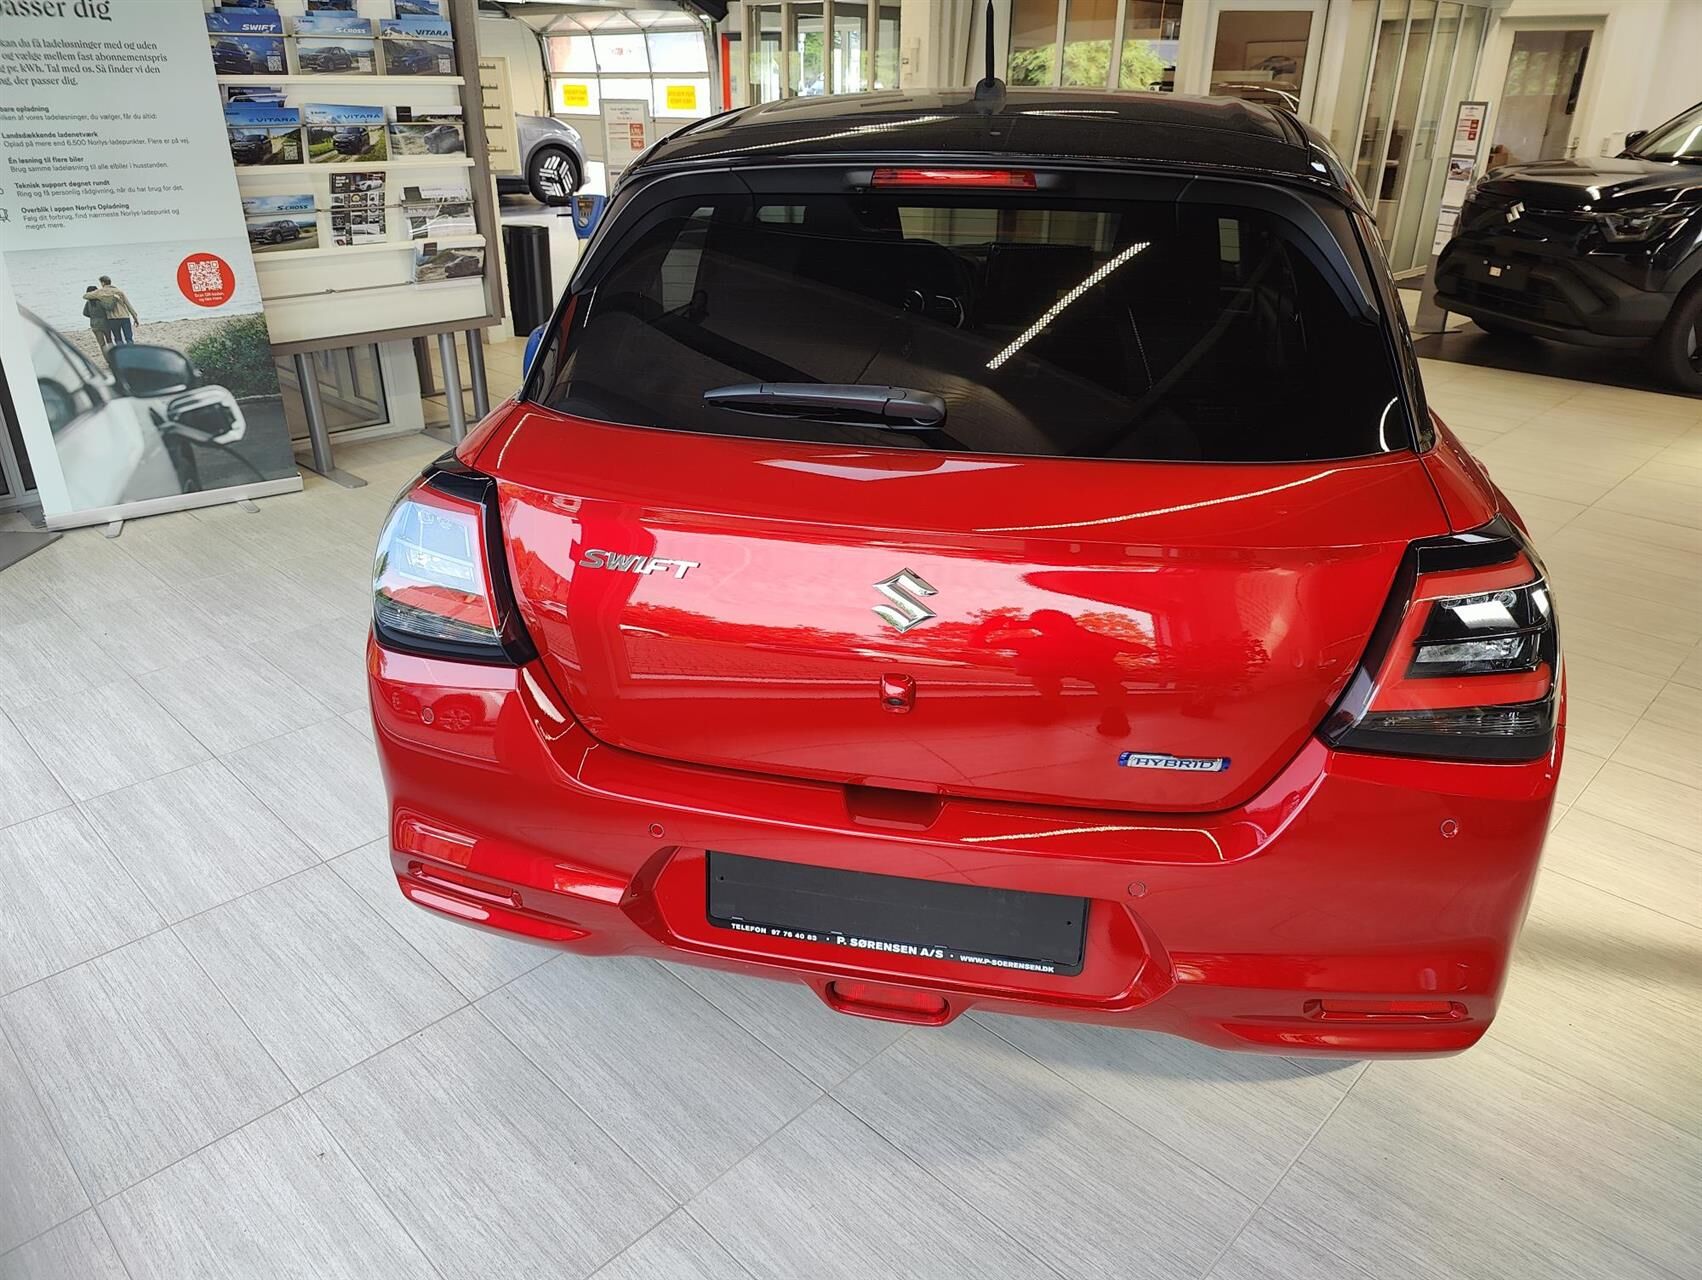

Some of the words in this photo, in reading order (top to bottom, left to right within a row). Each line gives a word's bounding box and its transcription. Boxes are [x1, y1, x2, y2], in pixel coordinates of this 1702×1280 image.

[0, 0, 66, 17] asser
[73, 0, 112, 21] dig
[241, 23, 277, 32] SWIFT
[18, 38, 31, 48] du
[104, 40, 122, 49] med
[123, 42, 135, 50] og
[136, 41, 158, 50] uden
[43, 51, 76, 61] mellem
[77, 51, 94, 61] fast
[95, 52, 168, 63] abonnementspris
[20, 63, 44, 73] kWh.
[44, 63, 60, 73] Tal
[61, 63, 81, 73] med
[95, 63, 107, 73] Så
[108, 63, 134, 73] finder
[135, 65, 143, 73] vi
[144, 64, 161, 73] den
[14, 75, 29, 86] der
[30, 78, 60, 87] passer
[61, 76, 79, 86] dig.
[16, 105, 50, 113] opladning
[21, 206, 49, 214] Overblik
[579, 548, 701, 579] SWIFT
[1134, 757, 1215, 769] HYBRID
[731, 923, 767, 934] TELEFON
[794, 932, 805, 940] 40
[836, 935, 847, 946] P.
[849, 938, 918, 954] SØRENSEN
[919, 946, 944, 958] A/S
[960, 955, 1055, 973] WWW.P-SOERENSEN.DK
